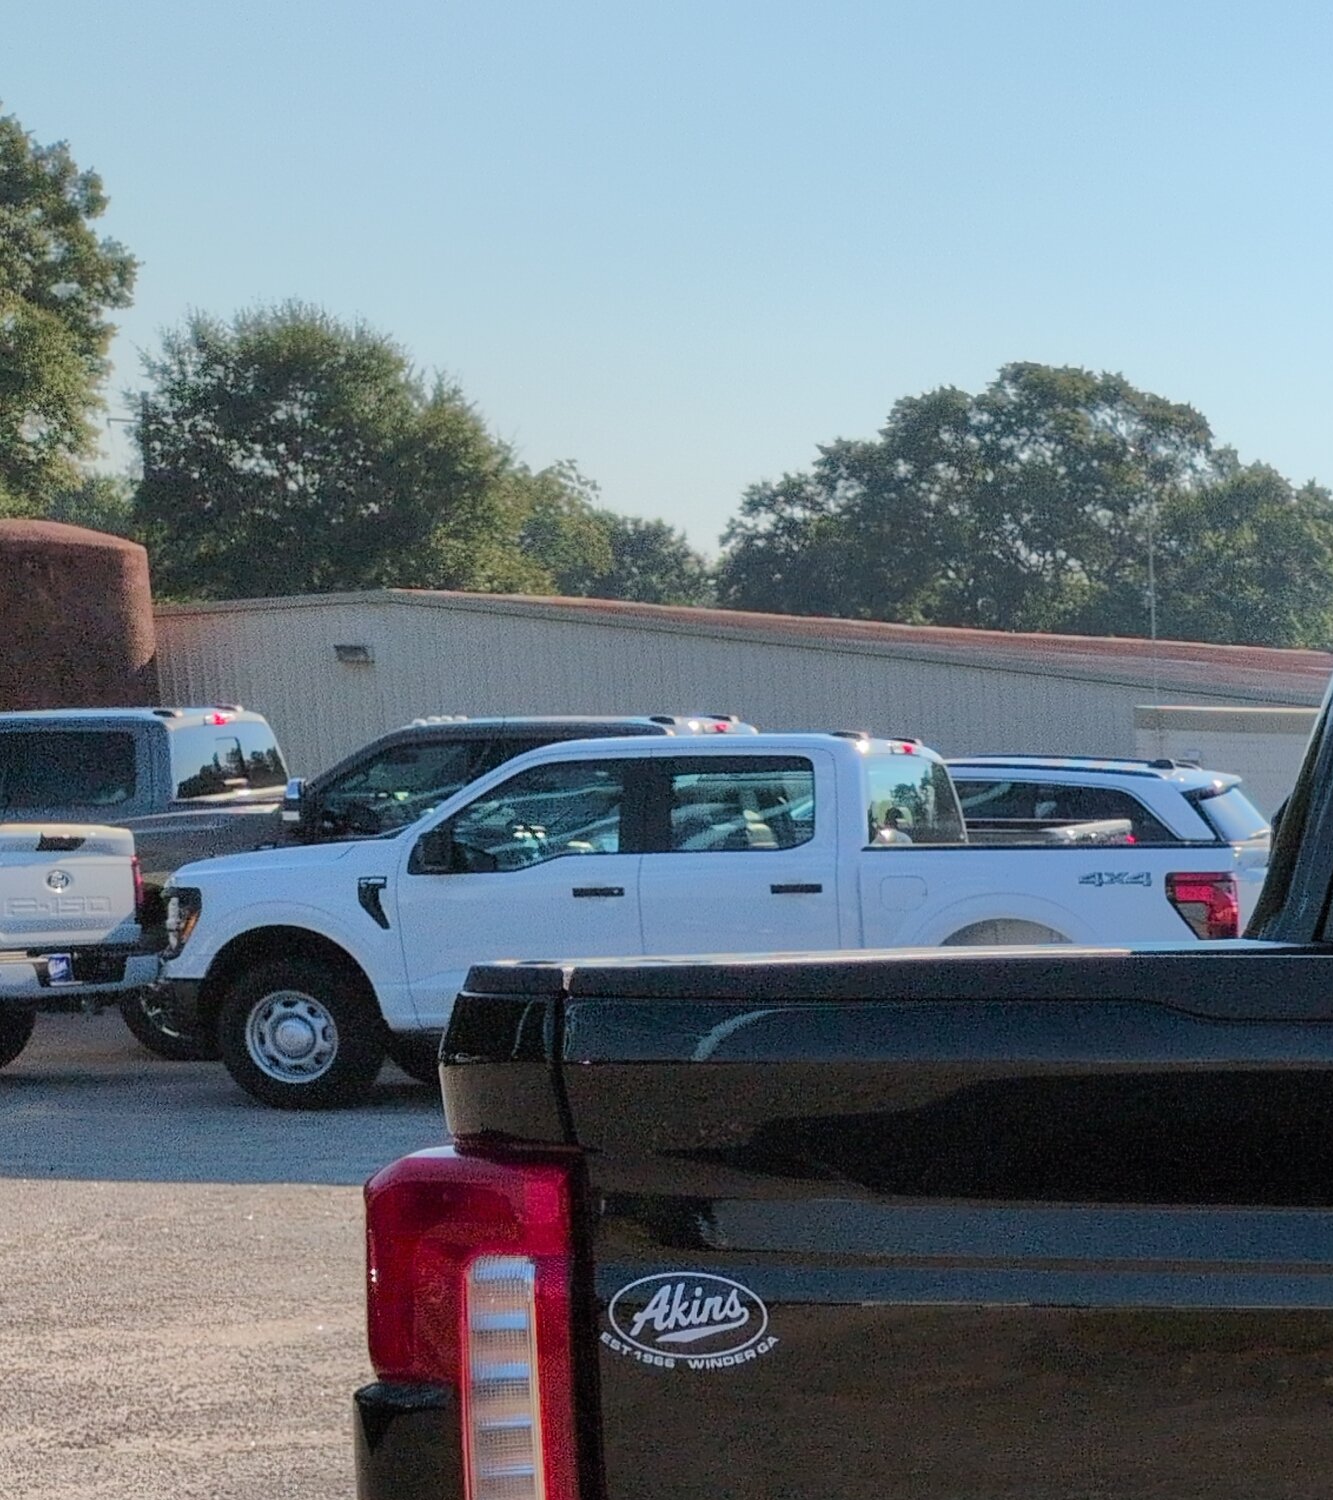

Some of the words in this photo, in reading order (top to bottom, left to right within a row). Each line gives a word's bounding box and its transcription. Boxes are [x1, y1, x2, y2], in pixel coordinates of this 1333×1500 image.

[629, 1282, 749, 1343] Akins
[600, 1331, 632, 1356] EST
[687, 1350, 757, 1370] WINDER
[757, 1335, 780, 1354] GA
